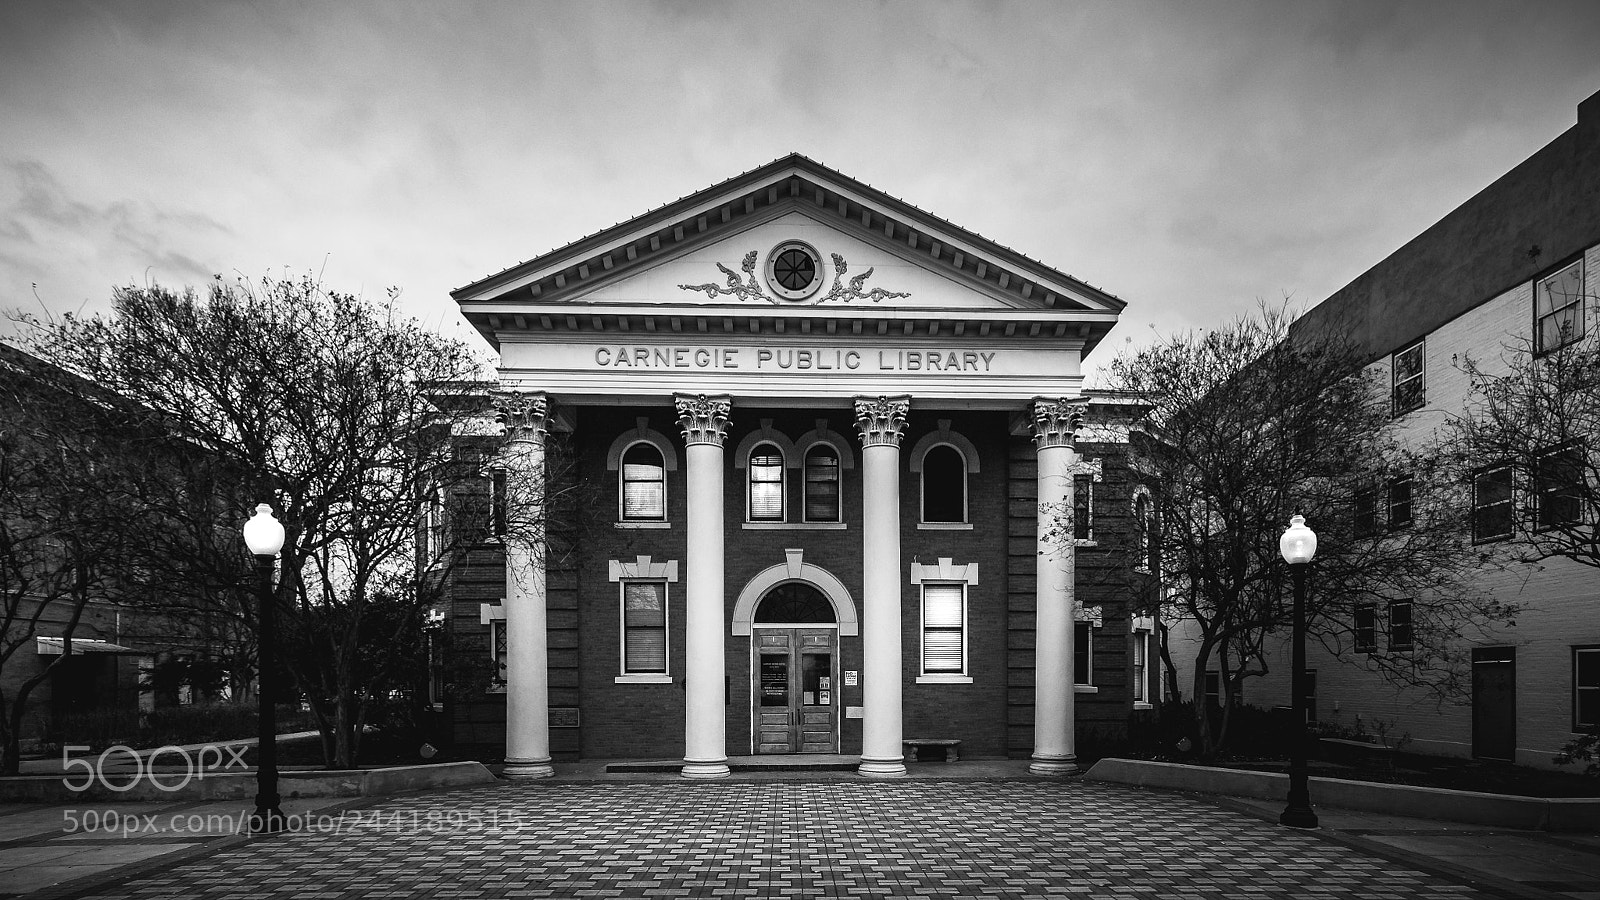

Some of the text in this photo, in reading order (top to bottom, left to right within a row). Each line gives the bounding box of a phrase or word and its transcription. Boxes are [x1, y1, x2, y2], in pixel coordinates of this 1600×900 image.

[595, 347, 996, 372] CARNEGIE PUBLIC LIBRARY
